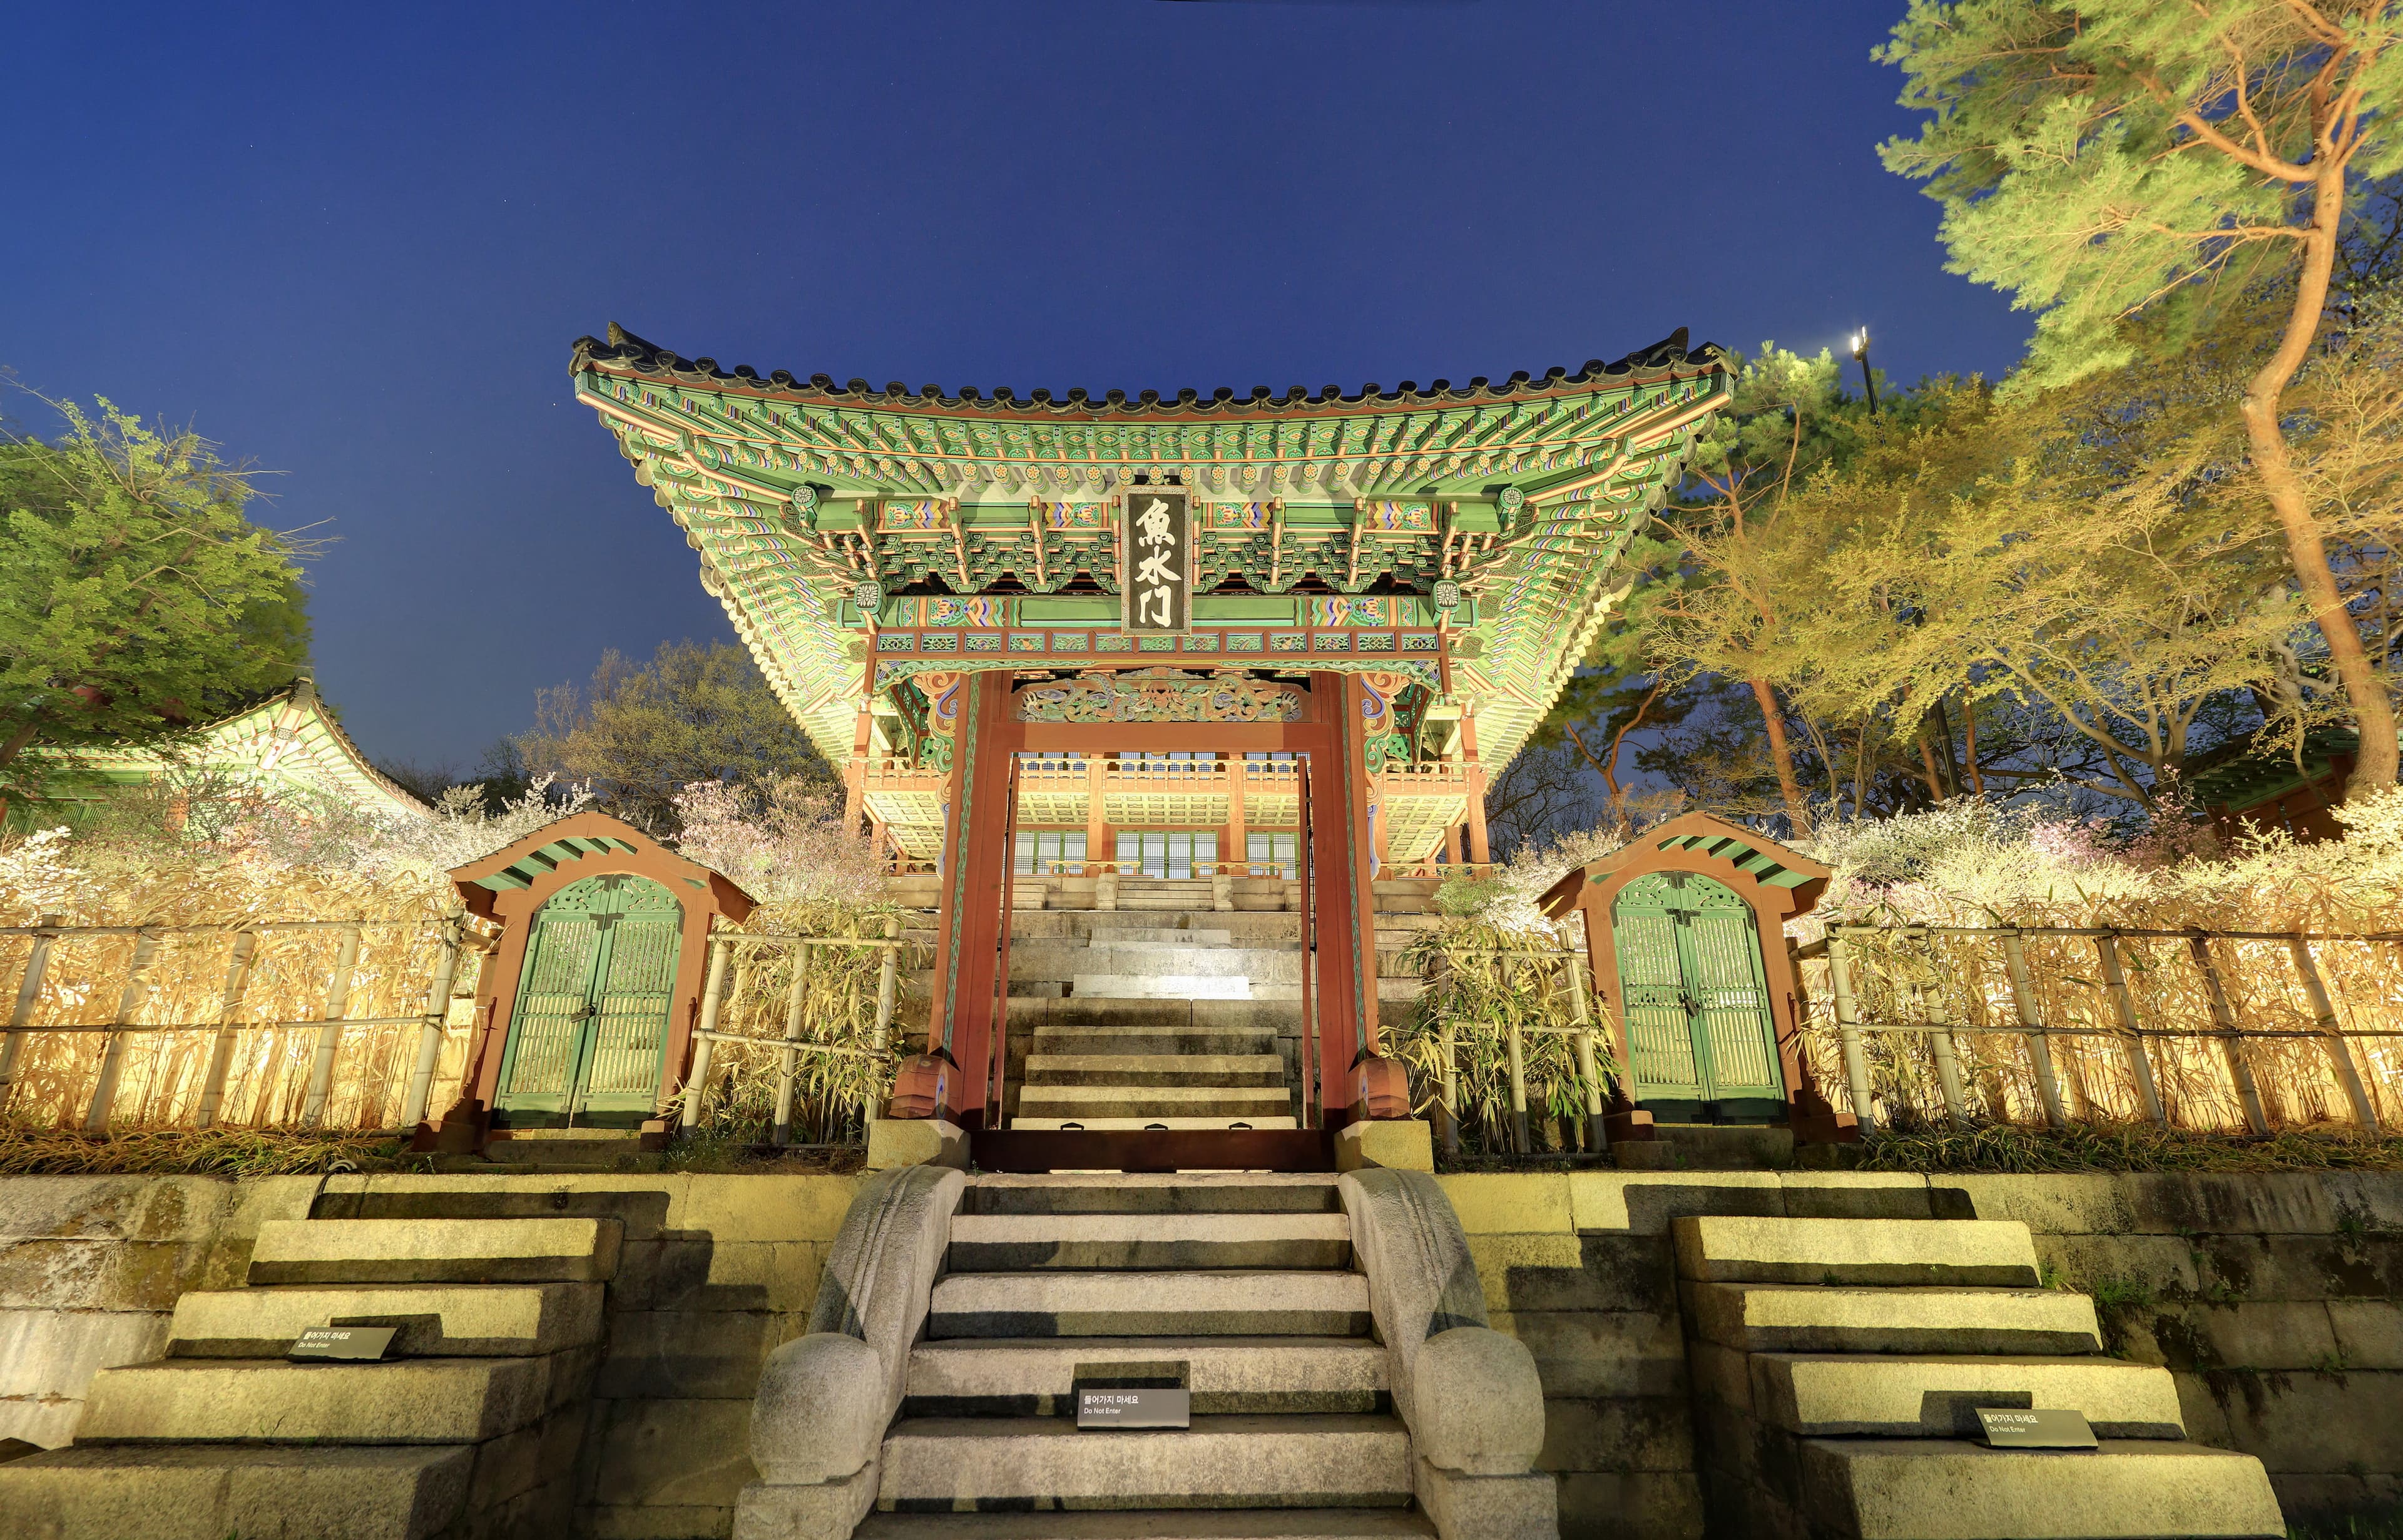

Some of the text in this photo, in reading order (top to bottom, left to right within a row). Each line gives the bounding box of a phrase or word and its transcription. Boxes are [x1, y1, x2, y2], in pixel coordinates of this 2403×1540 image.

[303, 1331, 351, 1340] 들어가지 마세요
[1084, 1395, 1138, 1405] 들어가지 마세요
[1984, 1414, 2039, 1424] 들어가지 마세요
